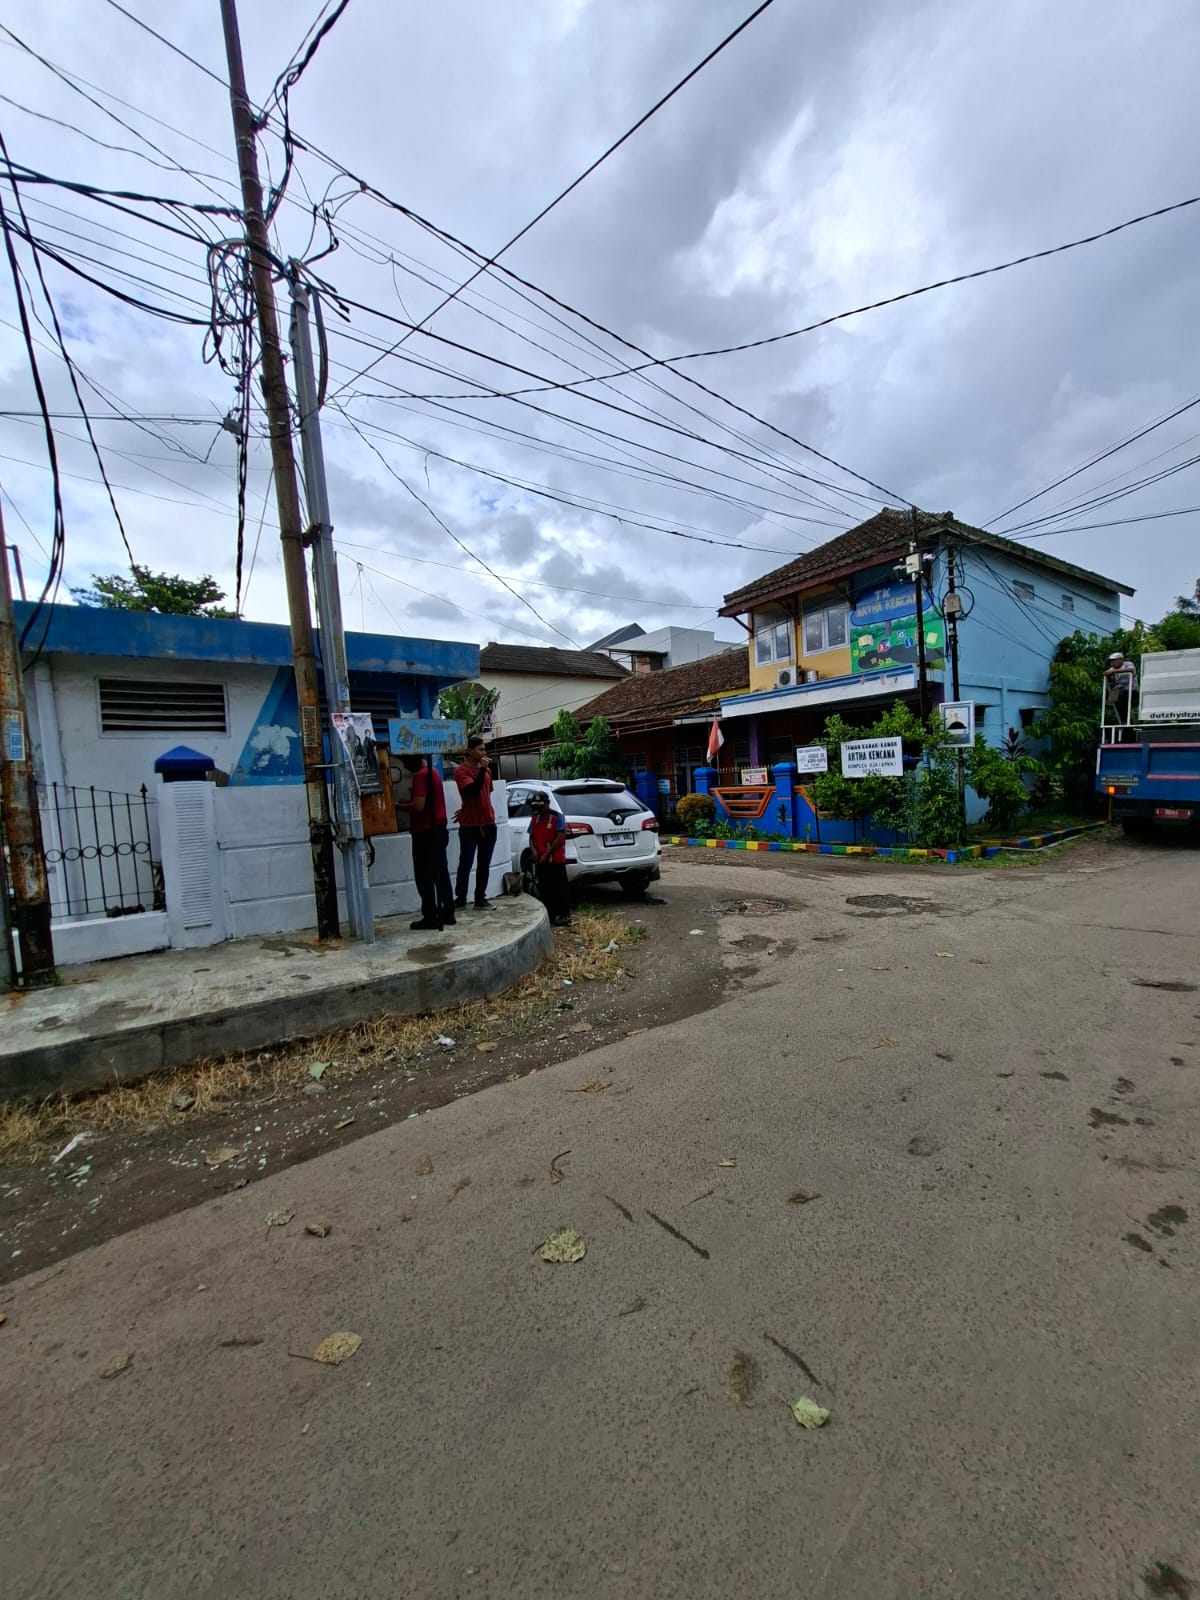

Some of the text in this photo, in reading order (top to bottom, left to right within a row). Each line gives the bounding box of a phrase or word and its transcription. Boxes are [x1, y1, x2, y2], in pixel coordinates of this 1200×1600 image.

[874, 587, 891, 601] TK
[856, 600, 882, 617] ARTHA
[848, 749, 896, 761] ARTHA KENCANA
